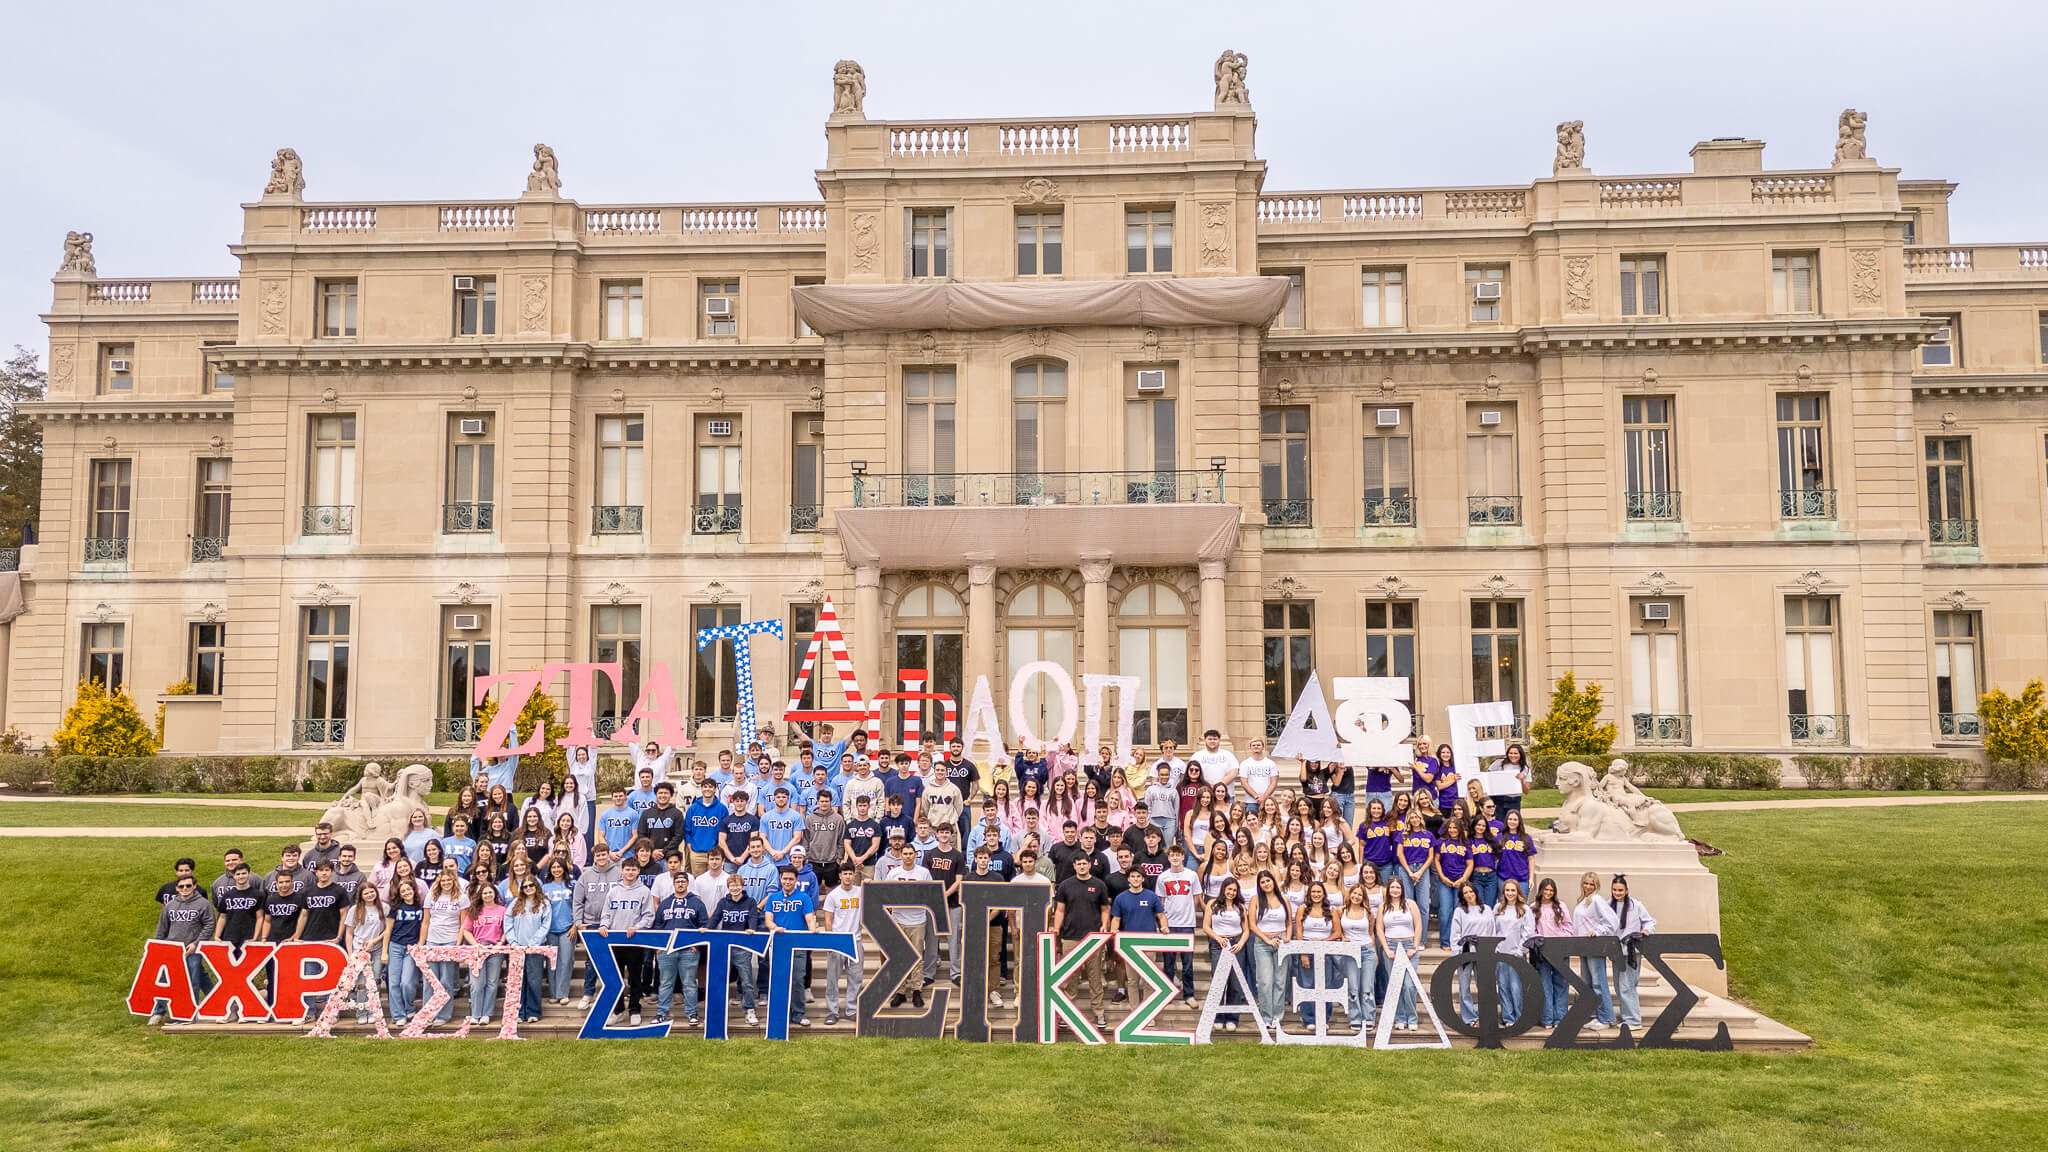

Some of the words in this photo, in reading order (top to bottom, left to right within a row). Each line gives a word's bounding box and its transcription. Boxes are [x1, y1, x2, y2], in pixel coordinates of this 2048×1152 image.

[607, 818, 631, 827] ΤΔΦ
[647, 817, 673, 829] ΤΔΦ
[692, 816, 719, 827] ΤΔΦ
[728, 822, 751, 833] ΤΔΦ
[769, 820, 792, 830] ΤΔΦ
[812, 822, 836, 831] ΤΔΦ
[932, 857, 953, 871] ΣΠ
[269, 881, 305, 893] ΑΡ
[1163, 880, 1191, 897] ΚΣ
[610, 900, 640, 910] ΣΤΓ
[840, 897, 860, 910] ΣΠ
[857, 880, 1053, 1043] ΣΠ
[576, 927, 859, 1041] ΣΤΓ
[1037, 931, 1197, 1045] ΚΣ
[1429, 933, 1734, 1052] ΦΣΣ
